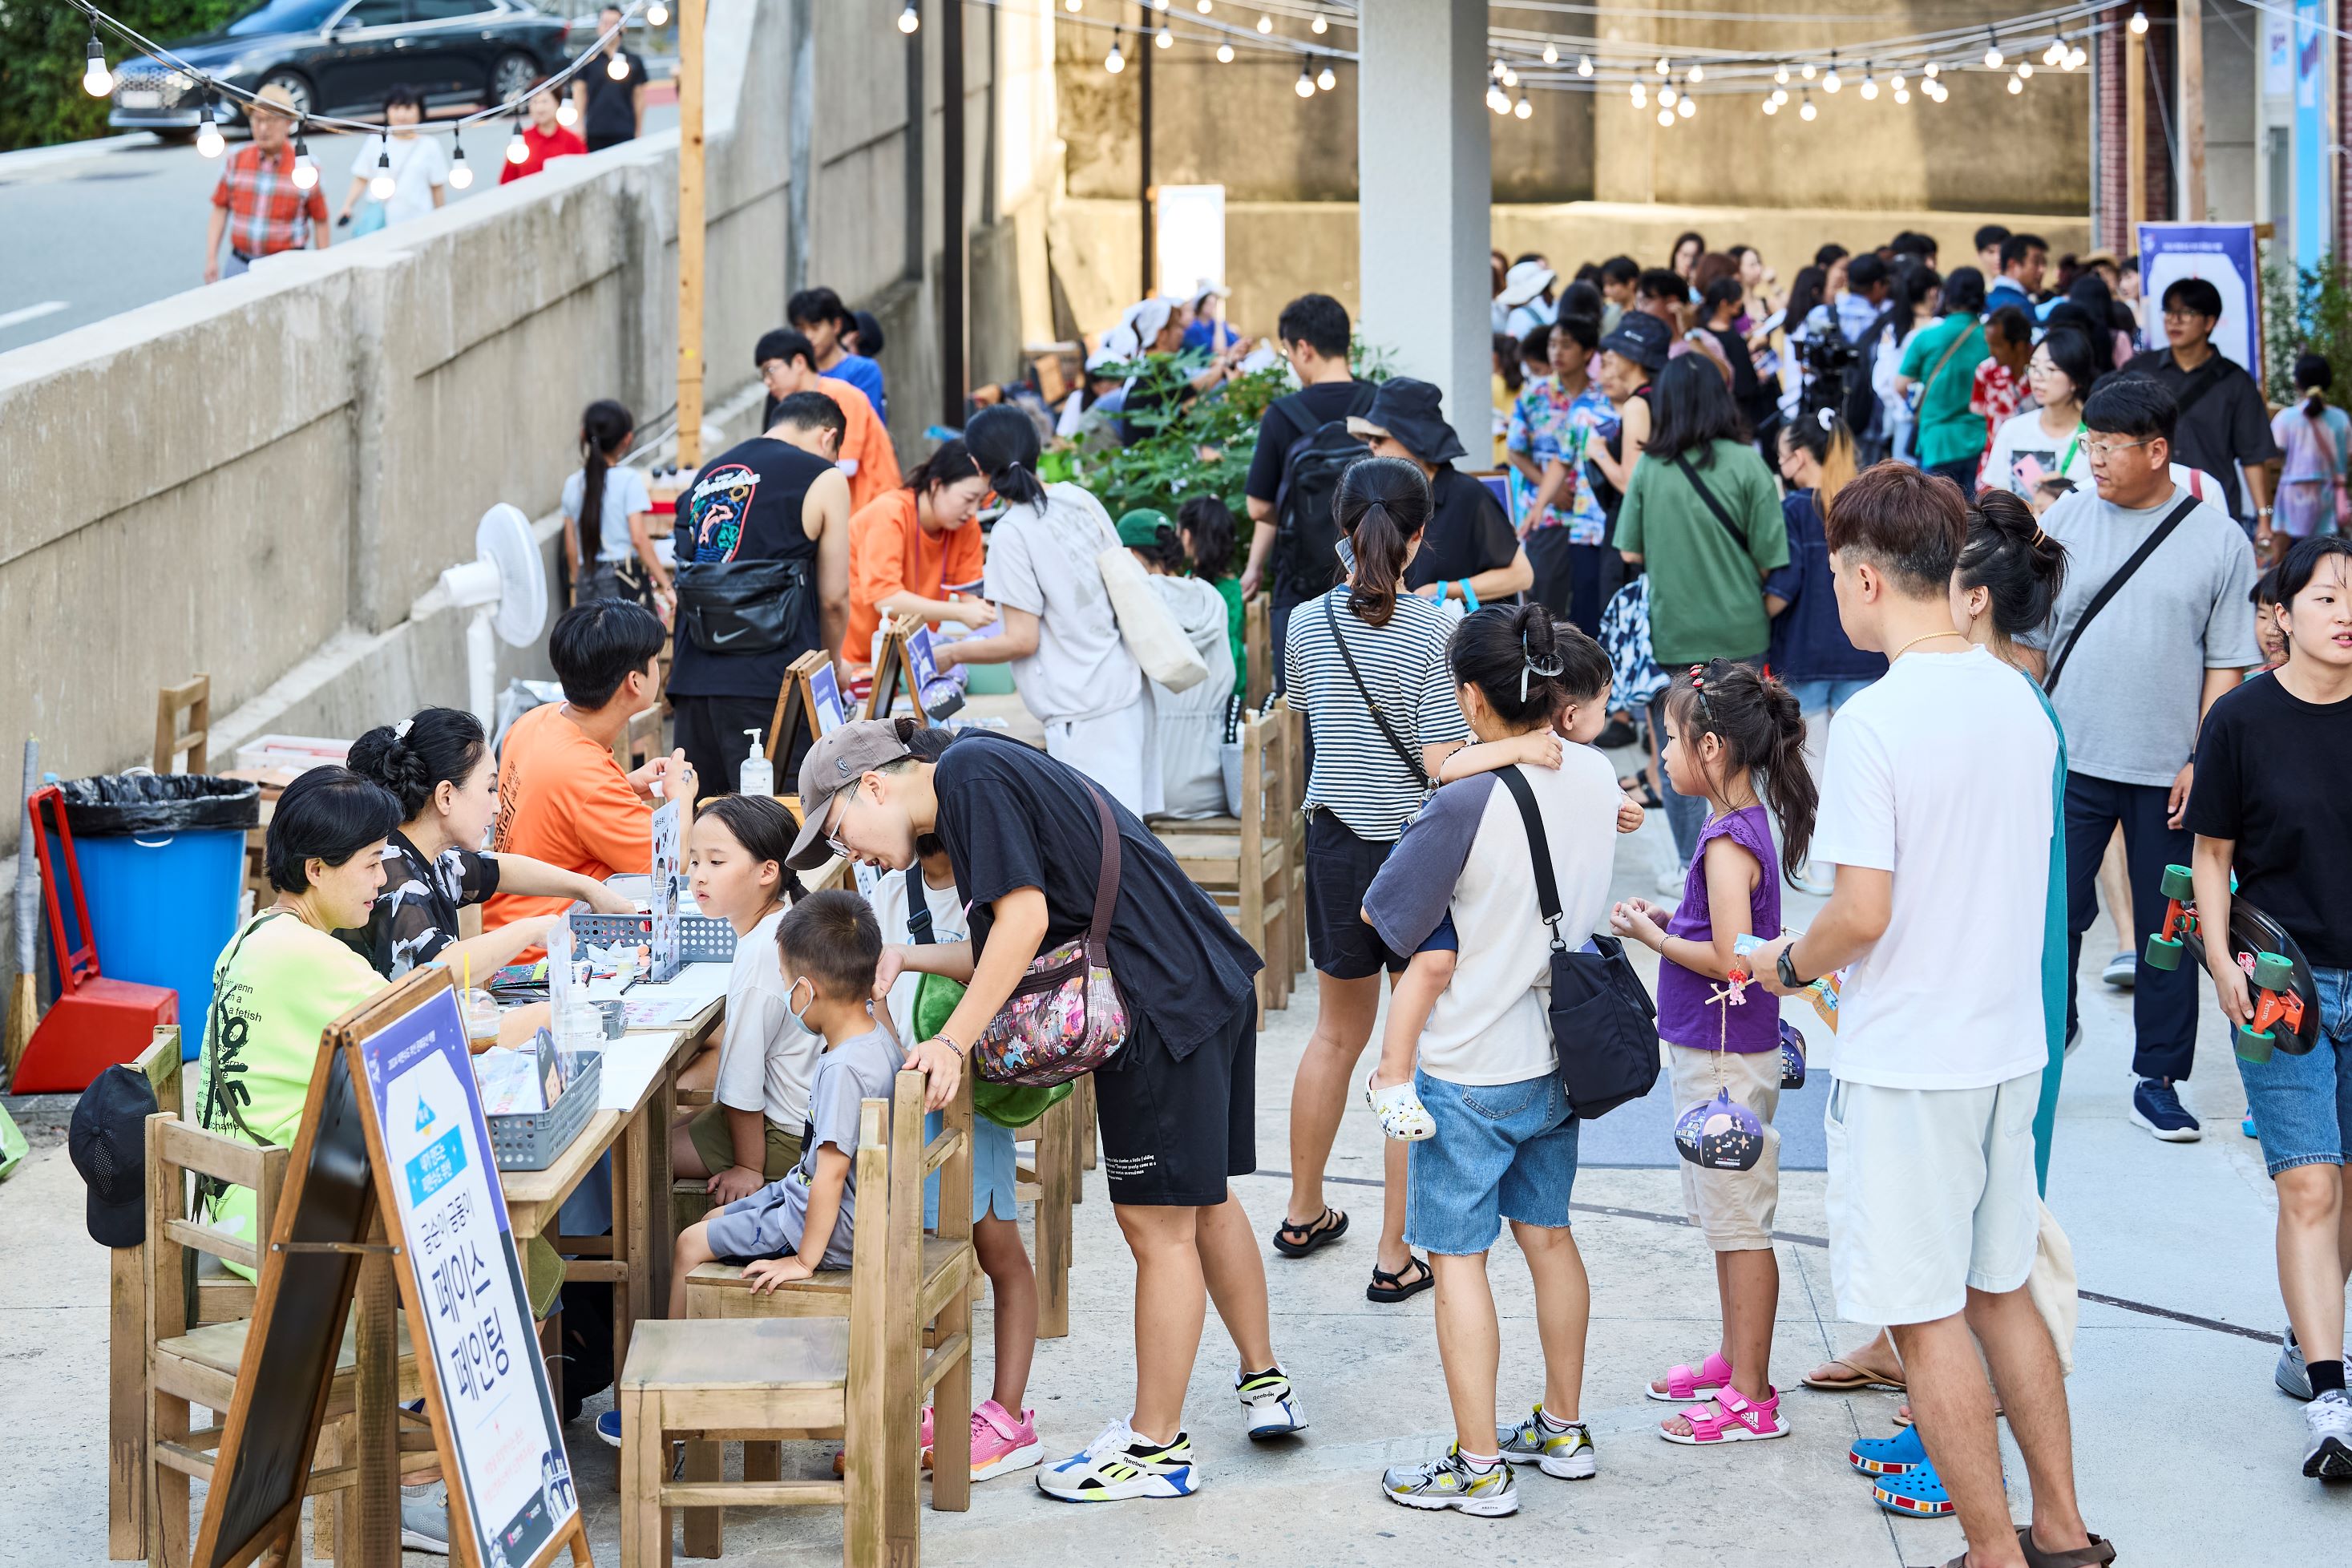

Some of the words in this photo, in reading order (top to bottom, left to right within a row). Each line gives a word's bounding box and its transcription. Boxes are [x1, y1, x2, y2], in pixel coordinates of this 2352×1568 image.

[236, 1007, 262, 1022] fetish
[2261, 999, 2275, 1021] Penny
[432, 1239, 491, 1323] 페이스
[451, 1307, 509, 1401] 페인팅
[1252, 1392, 1275, 1401] Reebok
[1740, 1413, 1760, 1429] adidas
[1123, 1457, 1147, 1469] Reebok
[1437, 1472, 1457, 1489] N
